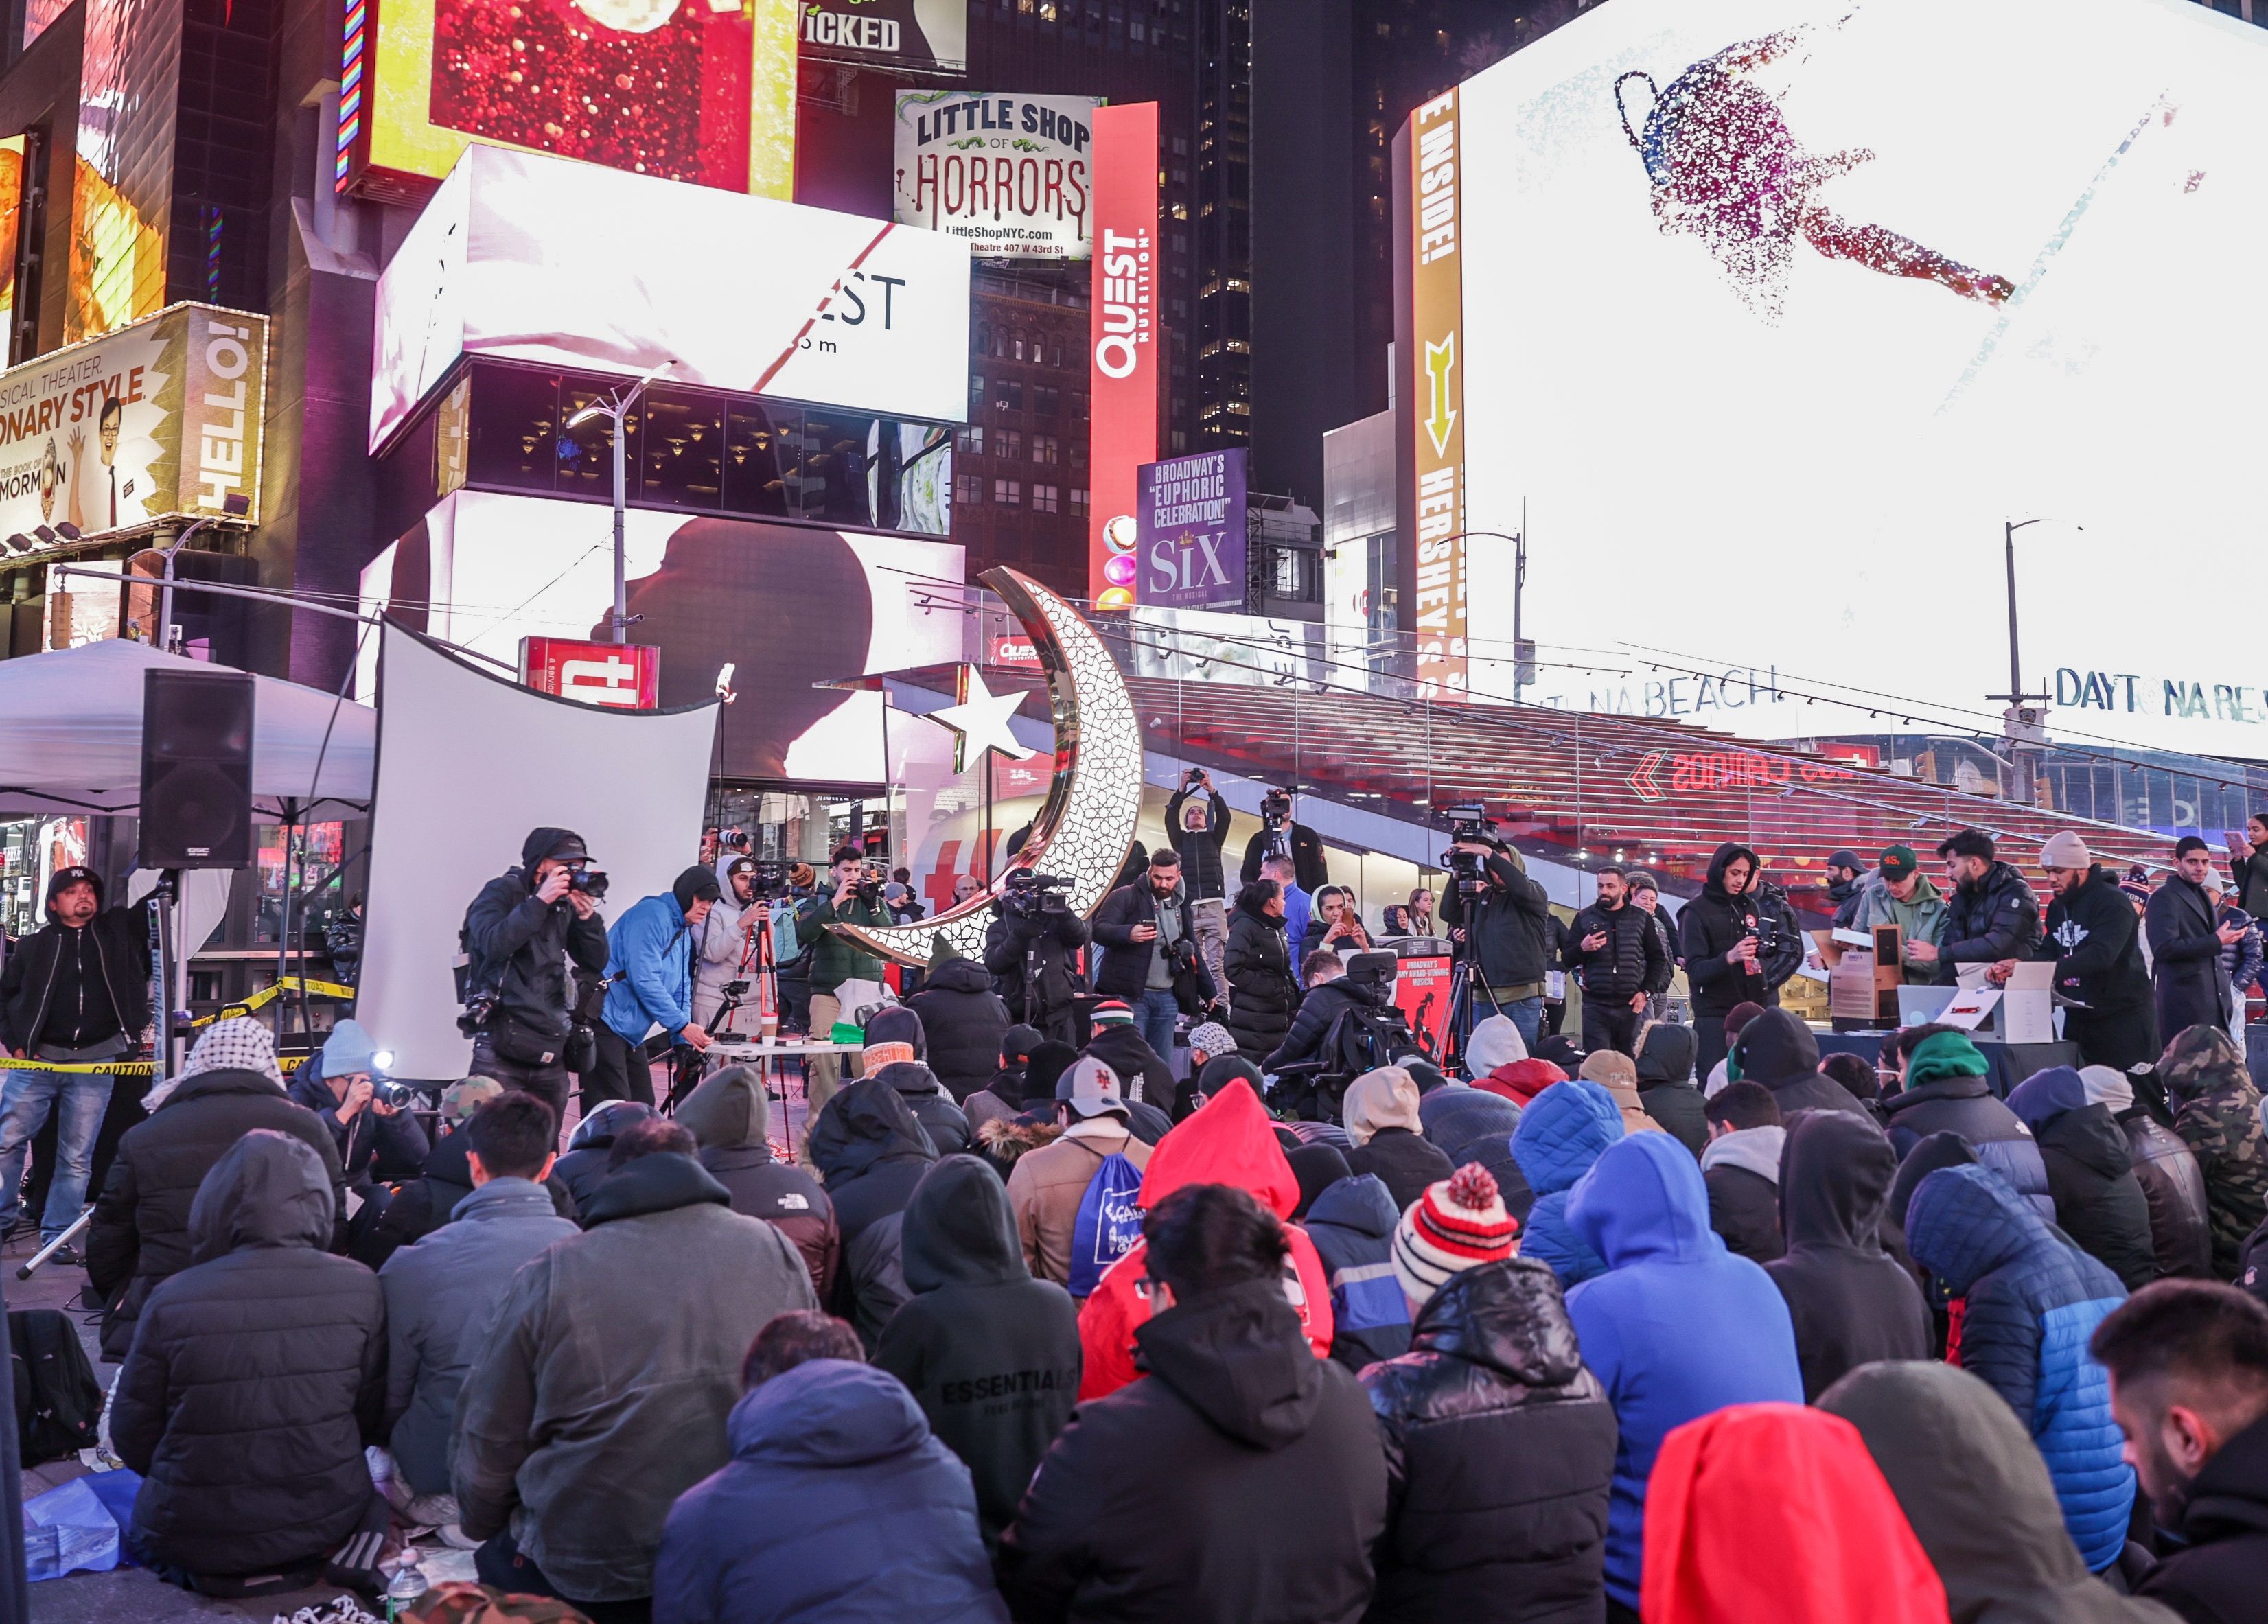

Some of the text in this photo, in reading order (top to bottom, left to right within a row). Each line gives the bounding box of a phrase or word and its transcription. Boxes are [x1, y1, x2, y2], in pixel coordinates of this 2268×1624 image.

[918, 100, 1090, 154] LITTLE SHOP
[990, 138, 1009, 149] OF
[915, 154, 1086, 237] HORRORS
[1420, 121, 1455, 265] INSIDE!
[1004, 244, 1019, 253] 407
[1022, 244, 1030, 253] W
[1032, 244, 1052, 254] 43rd
[1054, 245, 1063, 254] St
[1096, 229, 1136, 378] QUEST
[1139, 237, 1149, 342] NUTRITION
[42, 355, 102, 393] THEATER.
[70, 364, 146, 423] STYLE.
[196, 321, 250, 509] HELLO!
[1, 457, 42, 479] THE BOOK OF
[1155, 454, 1225, 484] BROADWAY'S
[1149, 531, 1231, 594] SIX
[1185, 592, 1207, 600] MUSICAL
[1645, 664, 1776, 718] BEACH
[1407, 960, 1437, 969] BROADWAY'S
[1413, 977, 1434, 986] MUSICAL
[92, 1064, 154, 1076] CAUTION
[942, 1369, 1076, 1404] ESSENTIALS
